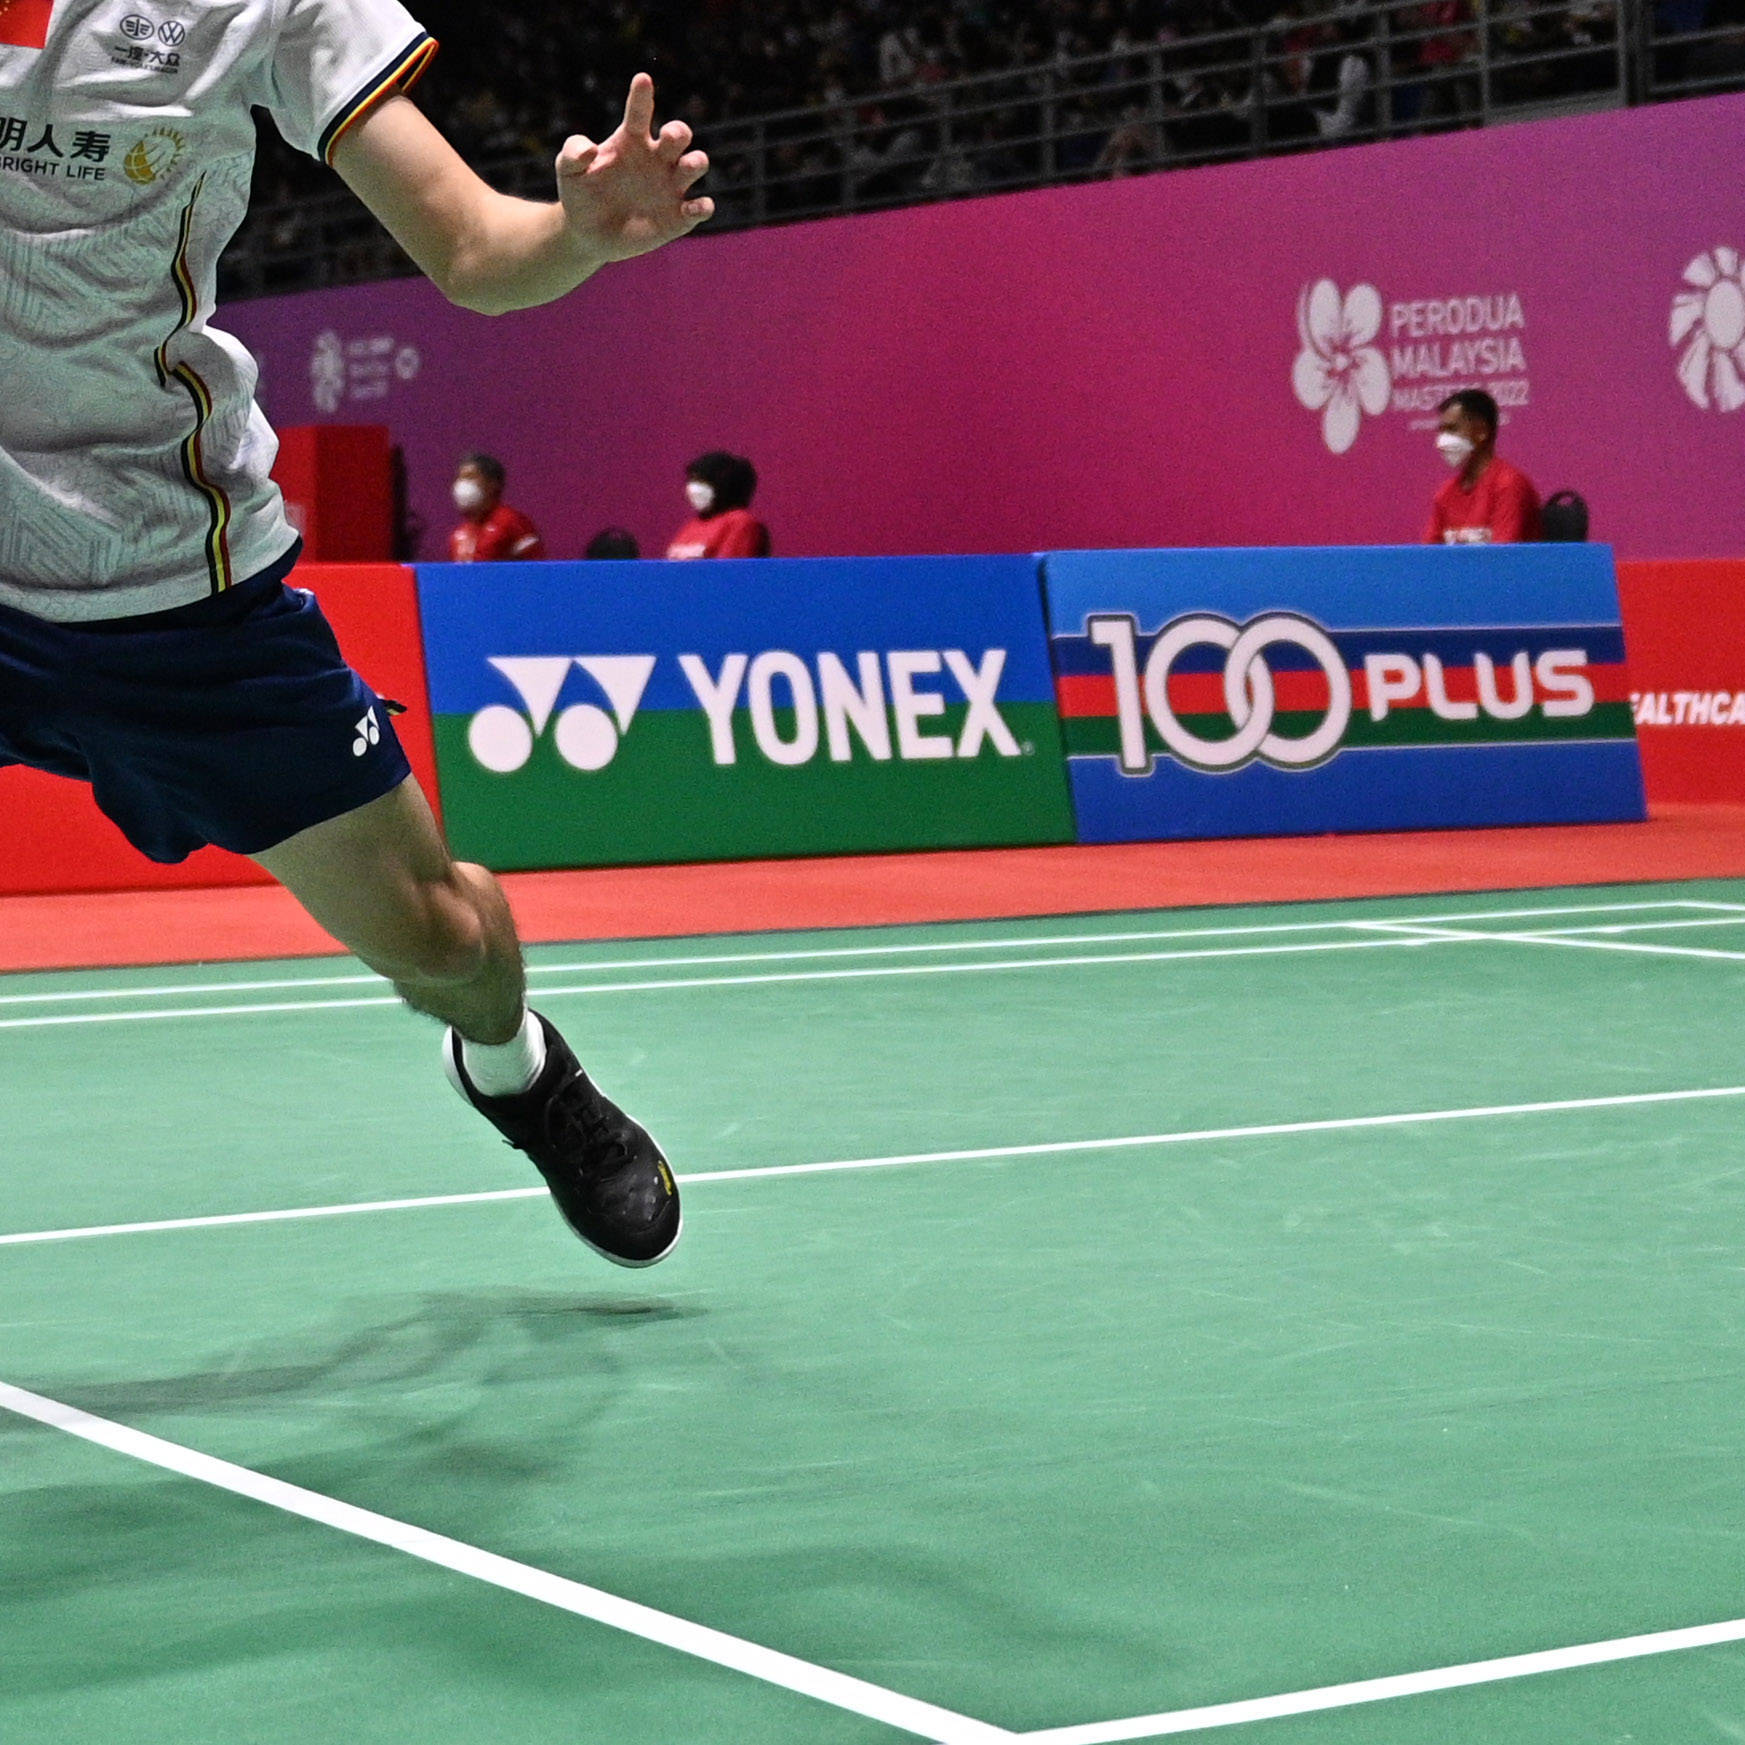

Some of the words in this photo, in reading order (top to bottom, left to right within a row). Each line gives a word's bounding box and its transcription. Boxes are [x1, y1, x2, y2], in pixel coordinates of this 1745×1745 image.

[66, 165, 105, 181] LIFE
[1391, 292, 1525, 337] PERODUA
[1392, 337, 1527, 378] MALAYSIA
[677, 649, 1023, 766] YONEX
[1085, 612, 1353, 776] 100
[1364, 650, 1596, 722] PLUS
